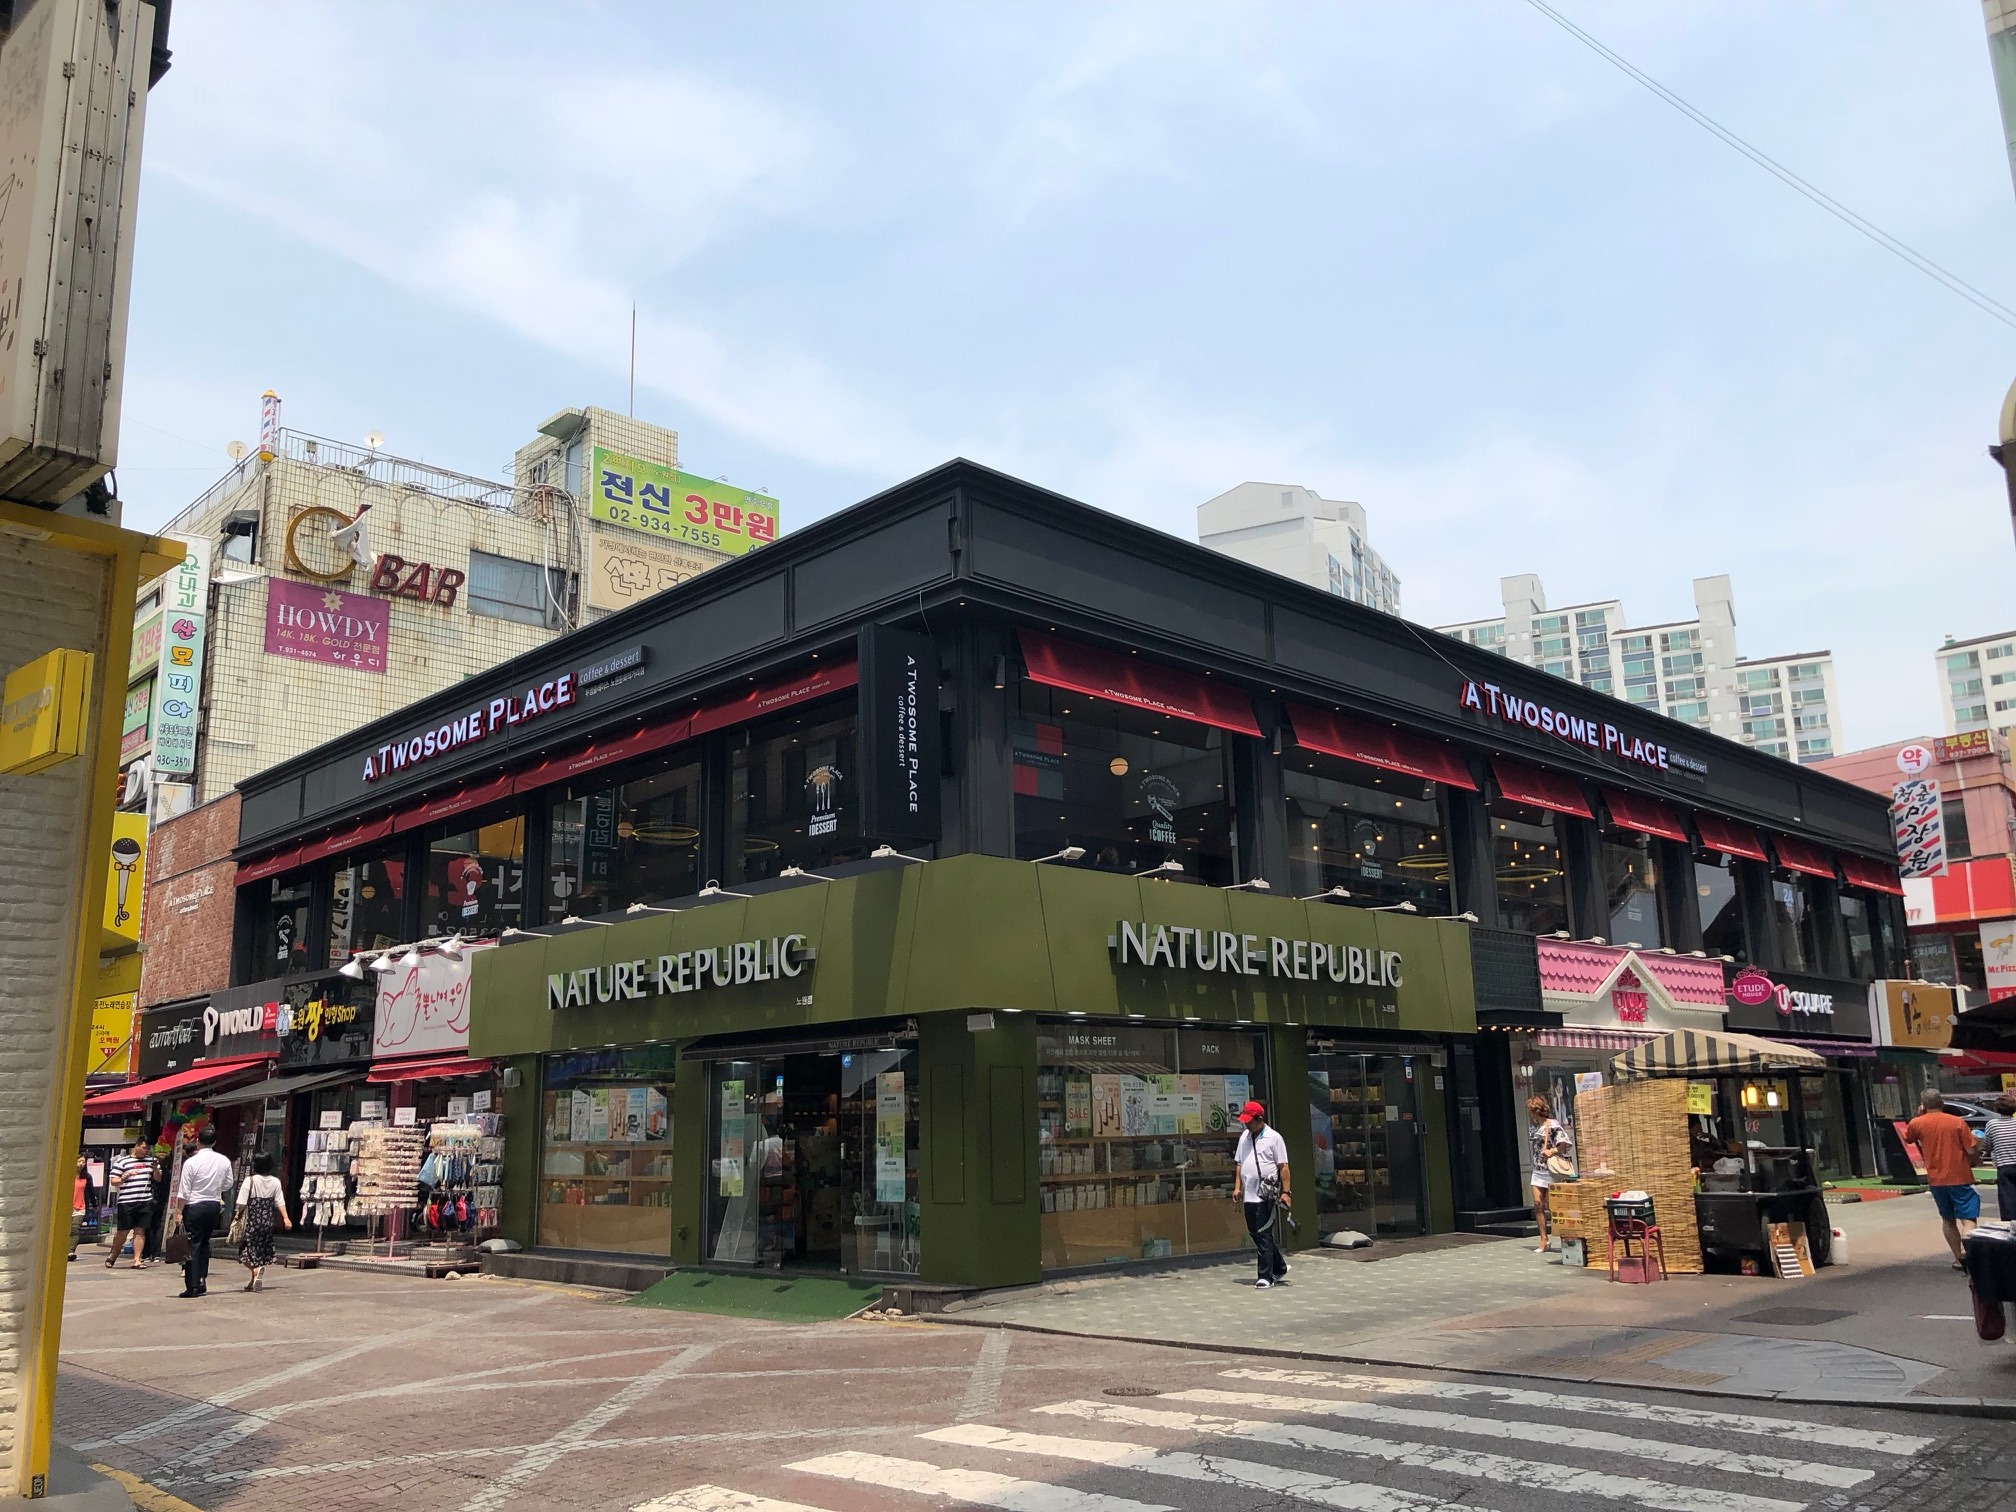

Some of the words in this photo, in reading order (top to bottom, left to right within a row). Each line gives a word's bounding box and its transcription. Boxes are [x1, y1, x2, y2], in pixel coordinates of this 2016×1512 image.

[609, 506, 721, 547] 02-934-7555
[684, 493, 775, 543] 3만원
[598, 538, 648, 560] 가정에서하는
[648, 551, 672, 564] 편안한
[370, 553, 466, 607] BAR
[277, 603, 382, 642] HOWDY
[278, 645, 317, 658] T.931-4574
[322, 637, 350, 649] GOLD
[353, 641, 380, 654] 전문점
[332, 651, 380, 667] 하우디
[162, 618, 198, 719] 산모피아
[579, 664, 604, 685] coffee
[610, 651, 640, 671] dessert
[907, 655, 916, 667] A
[762, 693, 791, 708] TWOSOME
[790, 686, 811, 699] PLACE
[897, 695, 907, 725] coffee
[907, 669, 918, 752] TWOSOME
[1108, 689, 1143, 703] TWOSOME
[1143, 697, 1165, 708] PLACE
[362, 756, 376, 782] A
[378, 709, 485, 774] TWOSOME
[489, 673, 575, 731] PLACE
[1465, 681, 1482, 709] A
[1483, 684, 1599, 747] TWOSOME
[1603, 722, 1670, 770] PLACE
[156, 755, 191, 768] 930-3571
[898, 733, 907, 767] dessert
[1902, 749, 1923, 767] 약
[908, 757, 919, 813] PLACE
[1898, 784, 1931, 803] 청춘
[1152, 829, 1177, 845] COFFEE
[1905, 804, 1932, 872] 미장원
[1122, 919, 1260, 976] NATURE
[1268, 936, 1404, 989] REPUBLIC
[548, 957, 648, 1010] NATURE
[658, 933, 806, 995] REPUBLIC
[1737, 983, 1766, 993] ETUDE
[1792, 991, 1835, 1017] SQUARE
[219, 1006, 264, 1037] WORLD
[304, 999, 324, 1042] 짱
[828, 1039, 851, 1049] NATURE
[852, 1037, 880, 1048] REPUBLIC
[1068, 1036, 1090, 1045] MASK
[1092, 1036, 1117, 1046] SHEET
[1201, 1044, 1220, 1055] PACK
[1069, 1107, 1089, 1119] SALE
